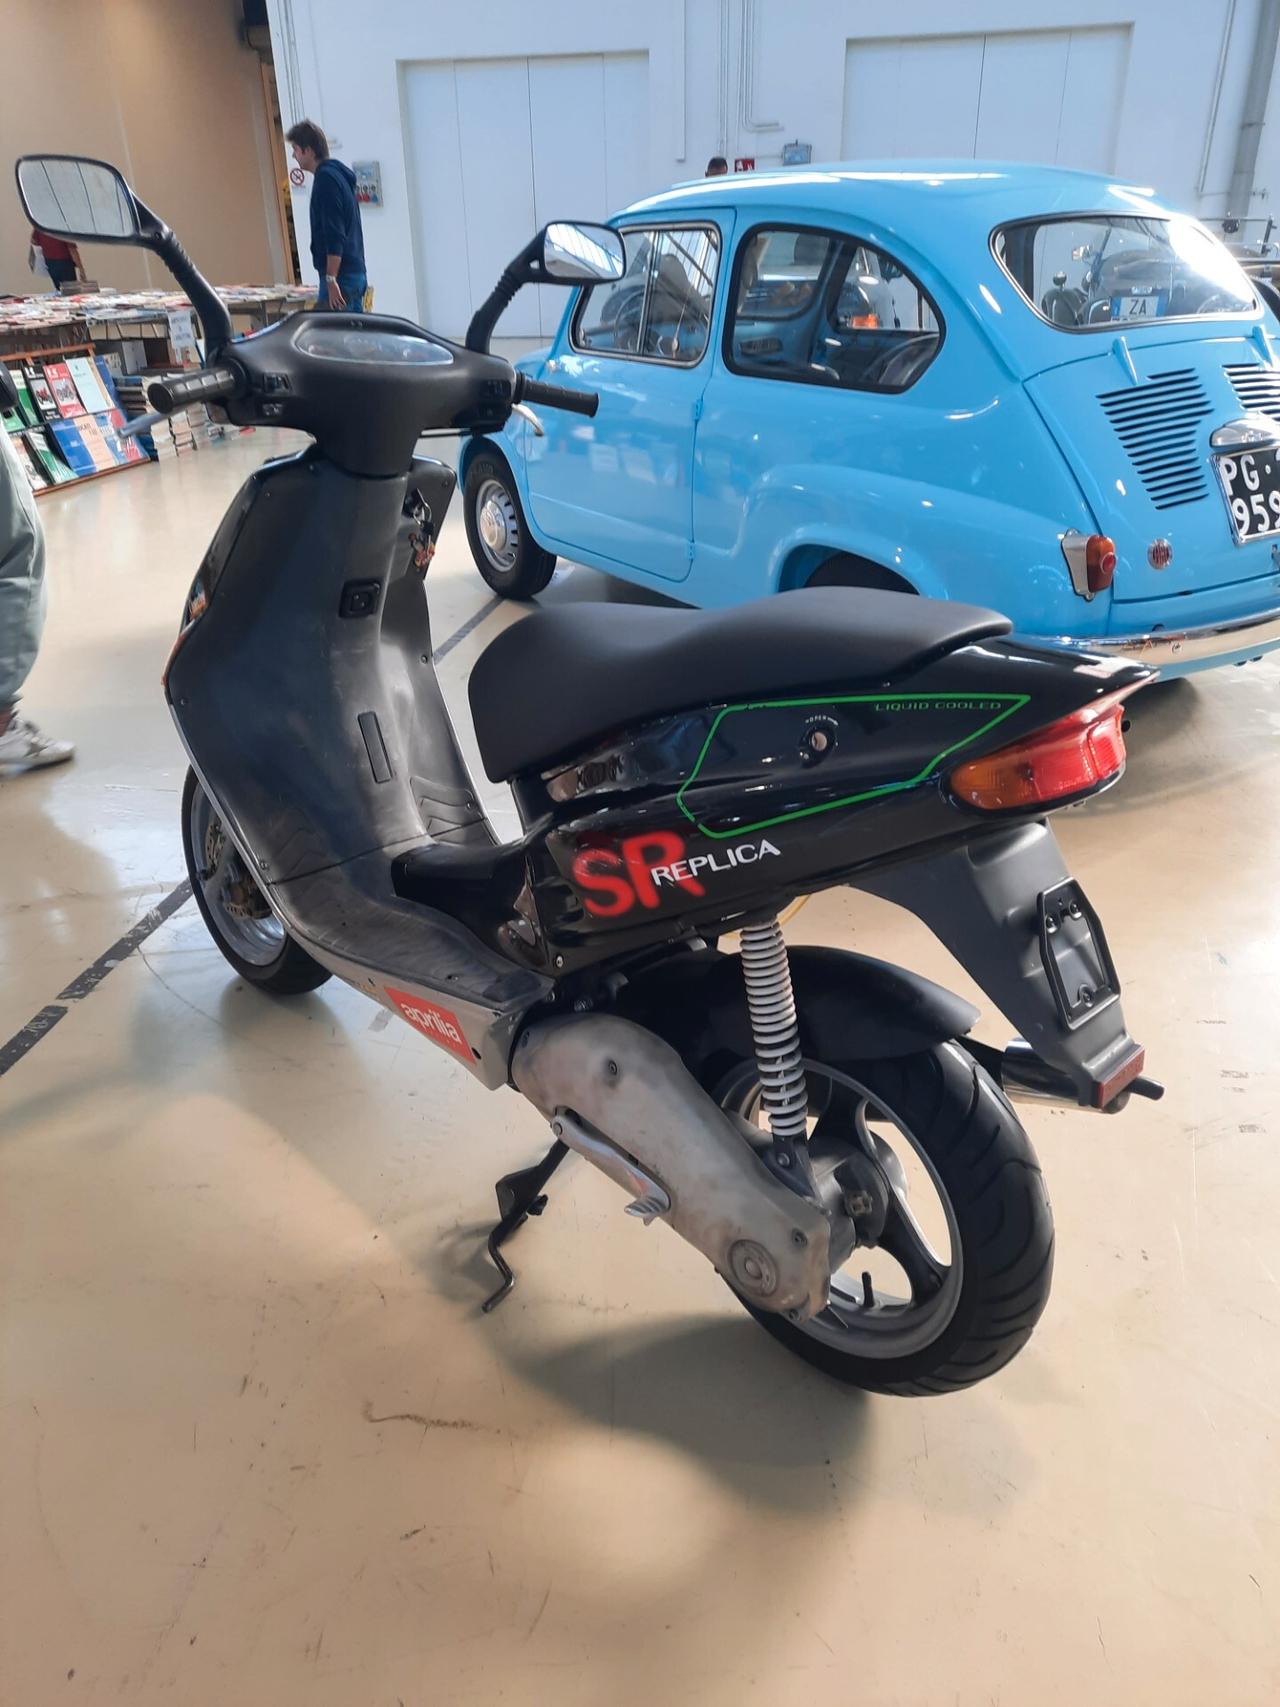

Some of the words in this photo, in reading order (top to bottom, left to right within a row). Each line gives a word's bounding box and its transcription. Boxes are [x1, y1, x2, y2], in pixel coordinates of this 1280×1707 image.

[1129, 298, 1147, 315] ZA
[875, 701, 930, 712] LIQUID
[934, 701, 1001, 710] COOLED
[573, 830, 706, 918] SR
[650, 839, 781, 887] REPLICA
[400, 1002, 463, 1045] aprilia
